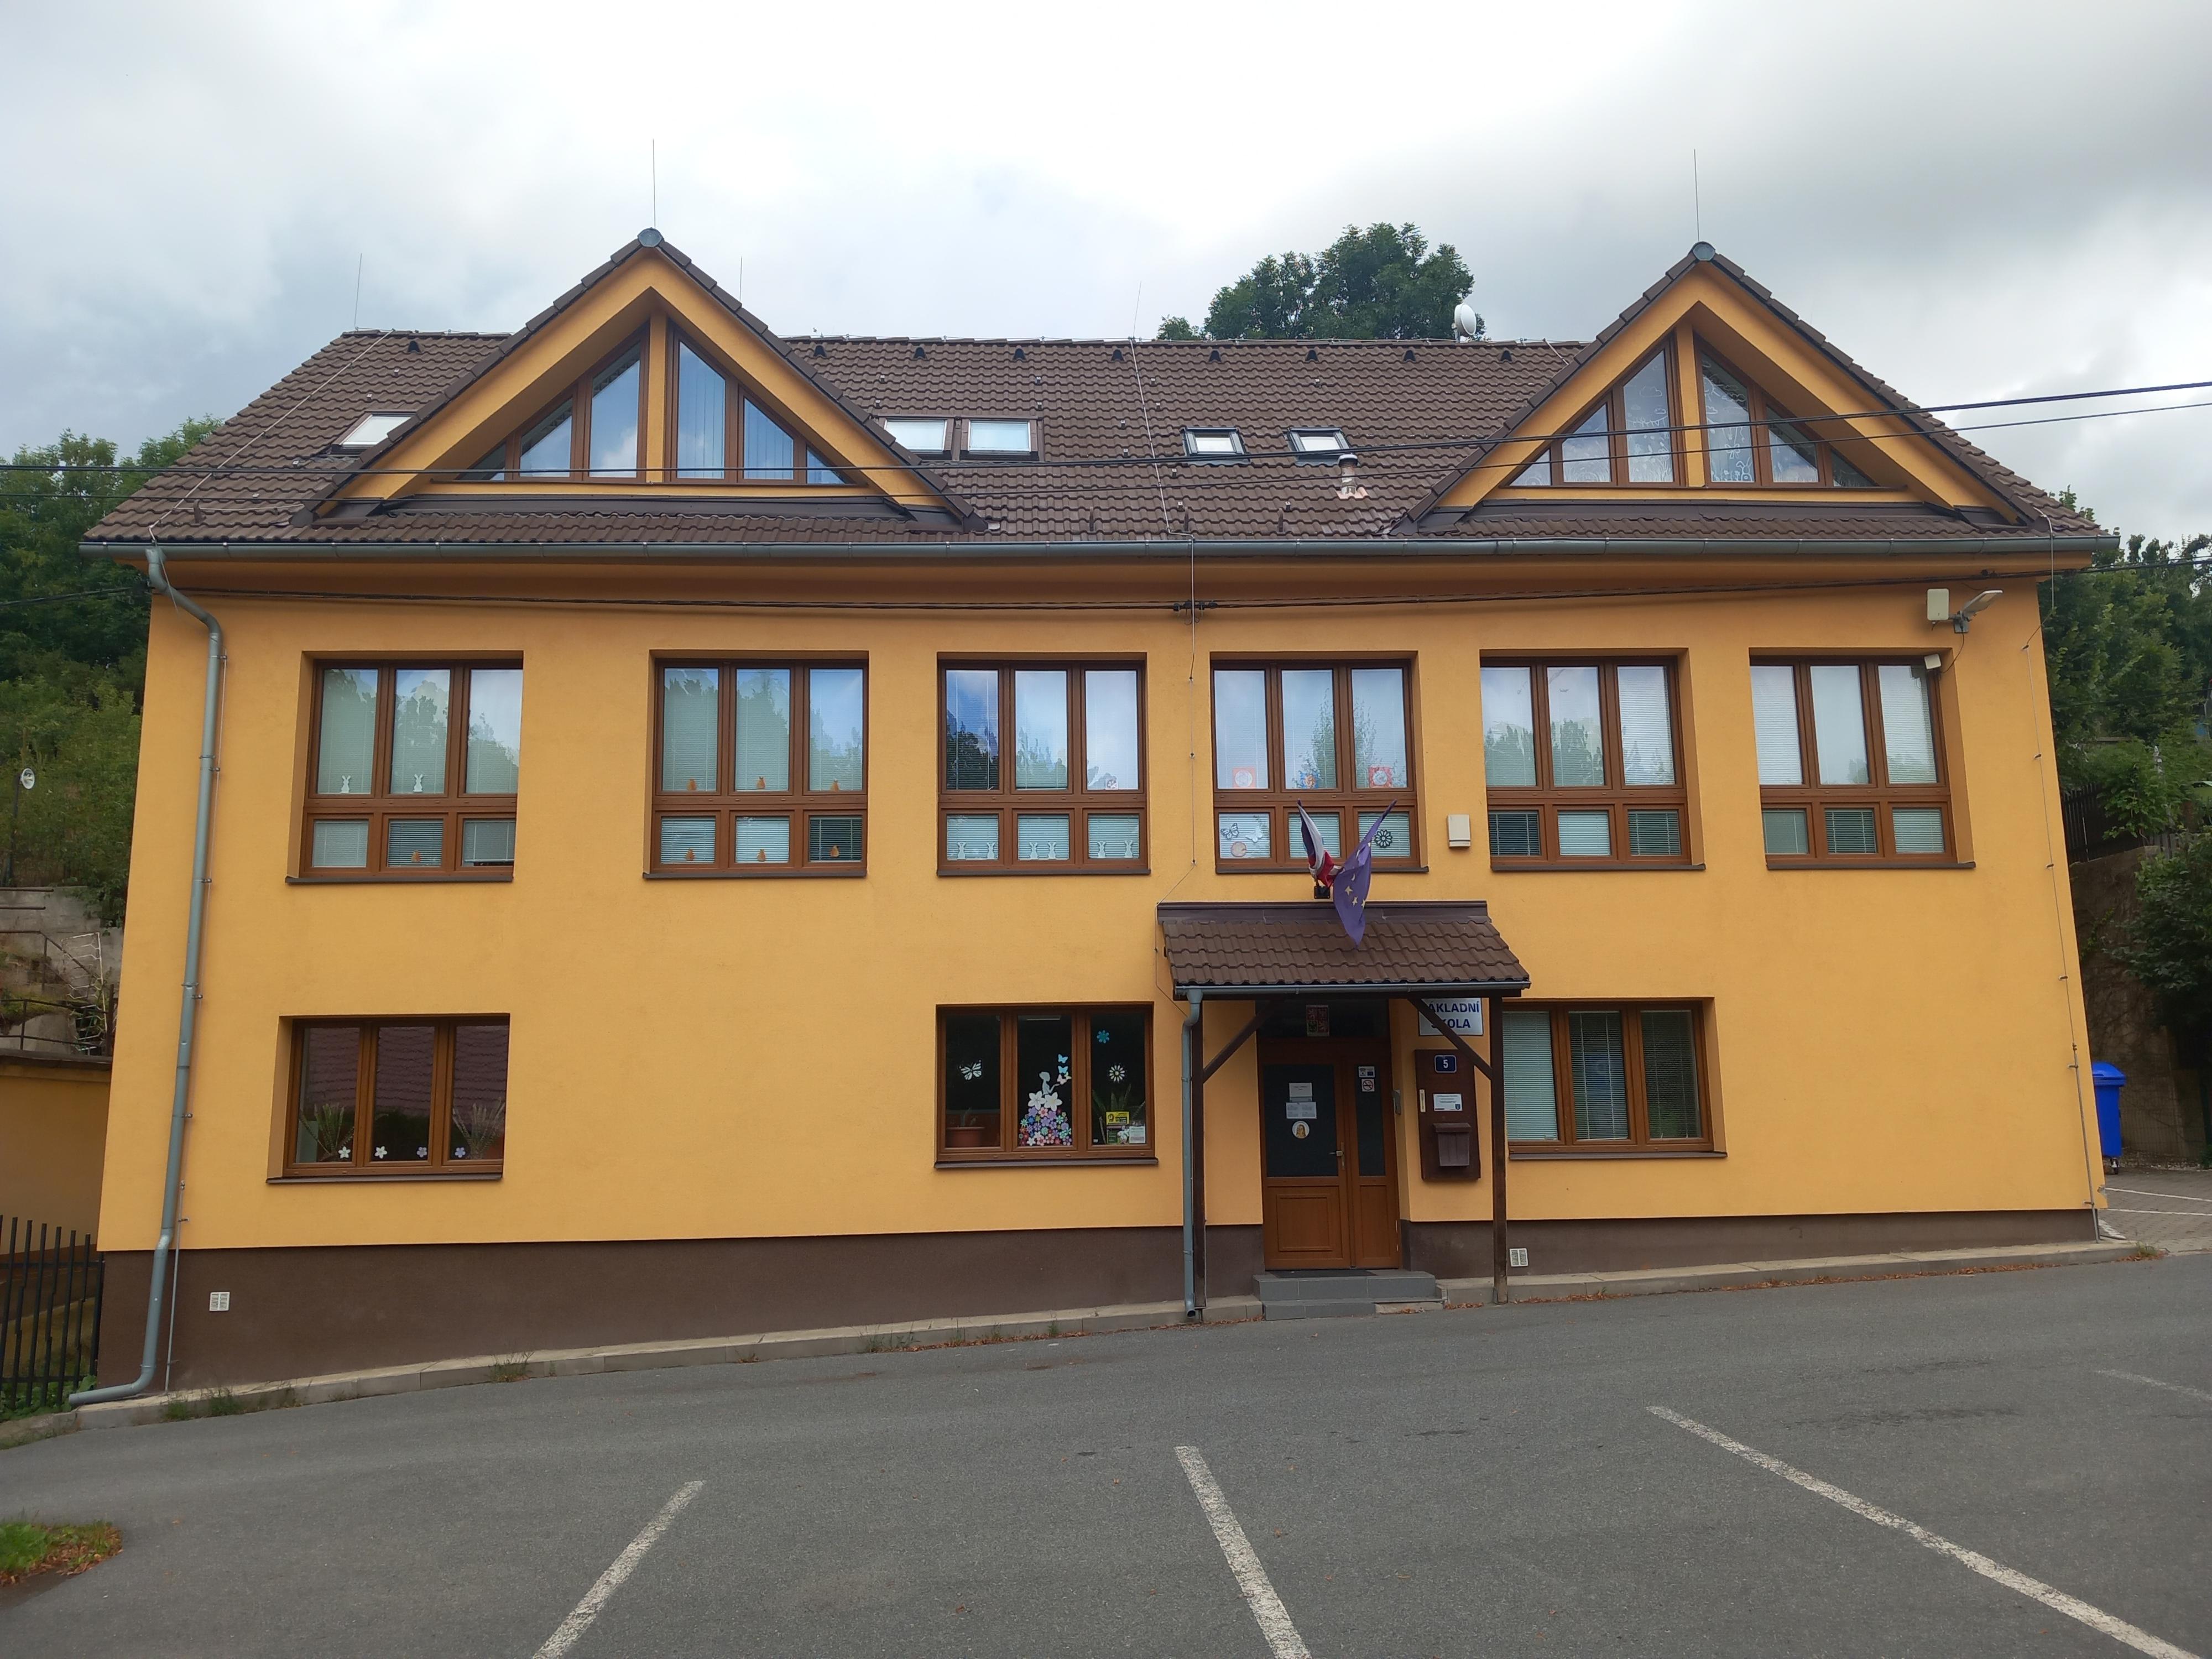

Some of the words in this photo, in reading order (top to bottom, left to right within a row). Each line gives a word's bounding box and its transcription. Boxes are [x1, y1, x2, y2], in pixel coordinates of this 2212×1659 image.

[1428, 1001, 1479, 1013] ÁKLADNÍ
[1431, 1019, 1471, 1028] OLA
[1443, 1059, 1448, 1068] 5
